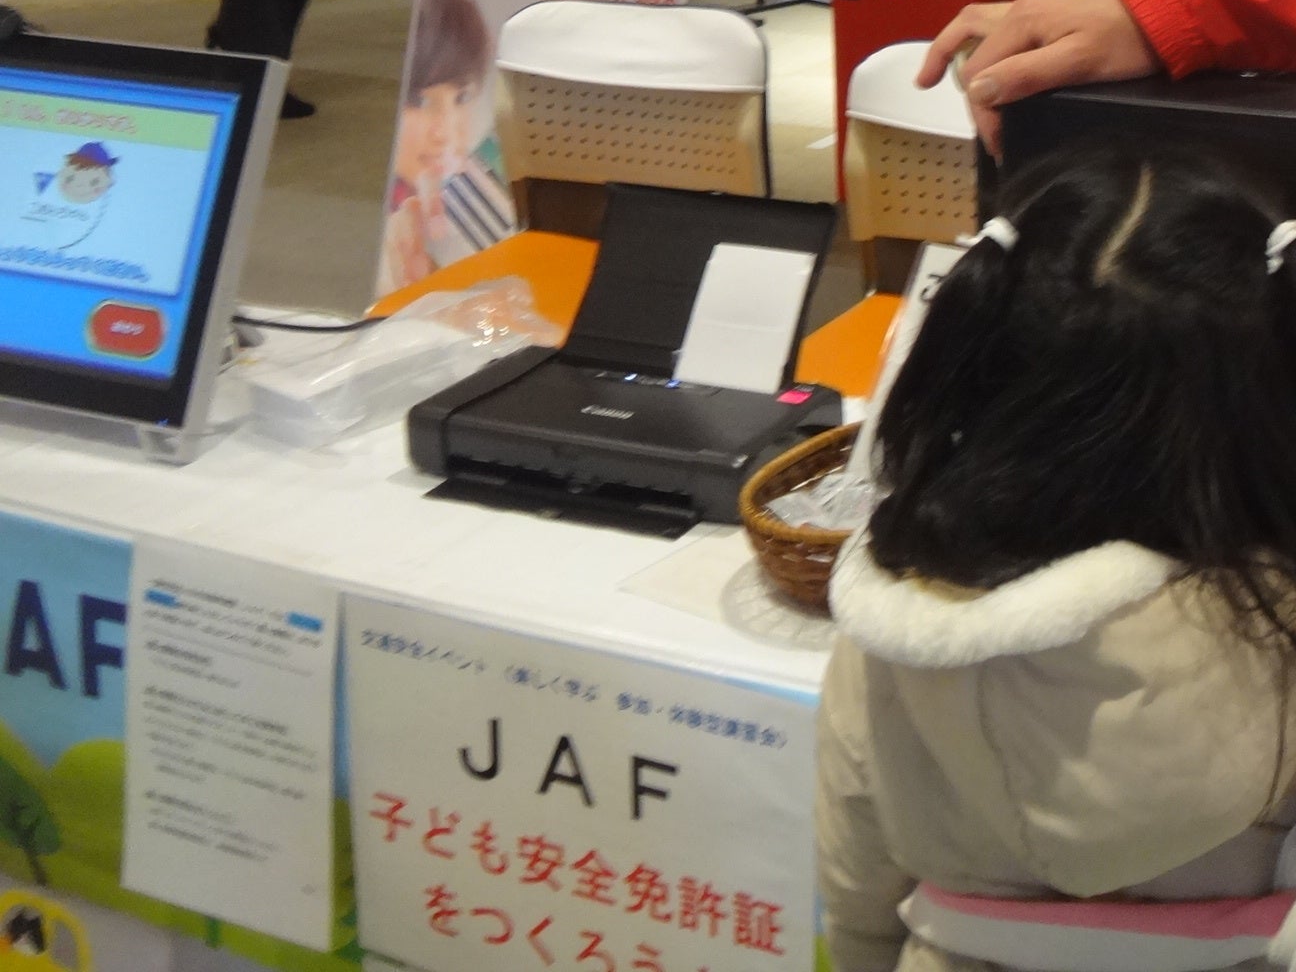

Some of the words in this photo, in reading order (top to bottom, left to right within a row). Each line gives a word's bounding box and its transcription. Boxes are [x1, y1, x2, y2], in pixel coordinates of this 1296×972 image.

[4, 578, 128, 699] AF
[459, 717, 680, 821] JAF
[369, 792, 786, 956] 子ども安全免許証
